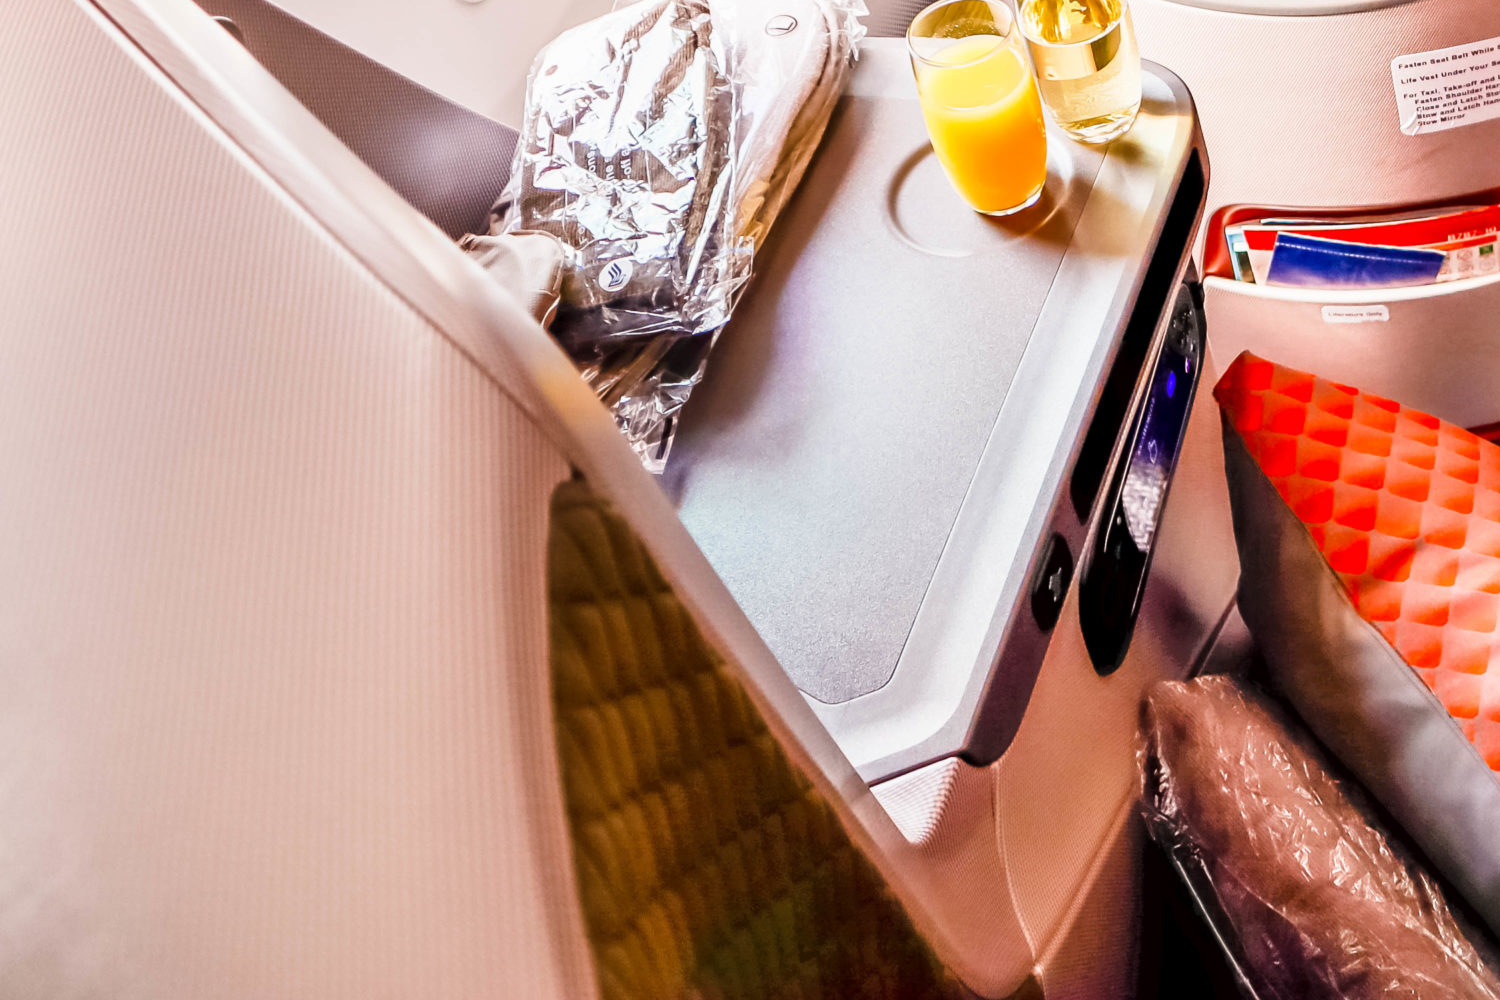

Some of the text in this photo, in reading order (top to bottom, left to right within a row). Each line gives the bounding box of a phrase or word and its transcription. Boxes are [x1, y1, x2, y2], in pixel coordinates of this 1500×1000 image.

[1398, 61, 1427, 69] Fasten
[1430, 56, 1449, 65] Seat
[1452, 52, 1469, 60] Belt
[1471, 47, 1494, 56] While
[1441, 68, 1466, 78] Under
[1469, 63, 1488, 71] Your
[1443, 80, 1477, 92] Take-off
[1480, 76, 1495, 84] and
[1415, 96, 1443, 104] Fasten
[1446, 88, 1482, 99] Shoulder
[1443, 99, 1458, 107] and
[1460, 95, 1483, 103] Latch
[1458, 102, 1481, 111] Latch
[1440, 113, 1465, 122] Mirror
